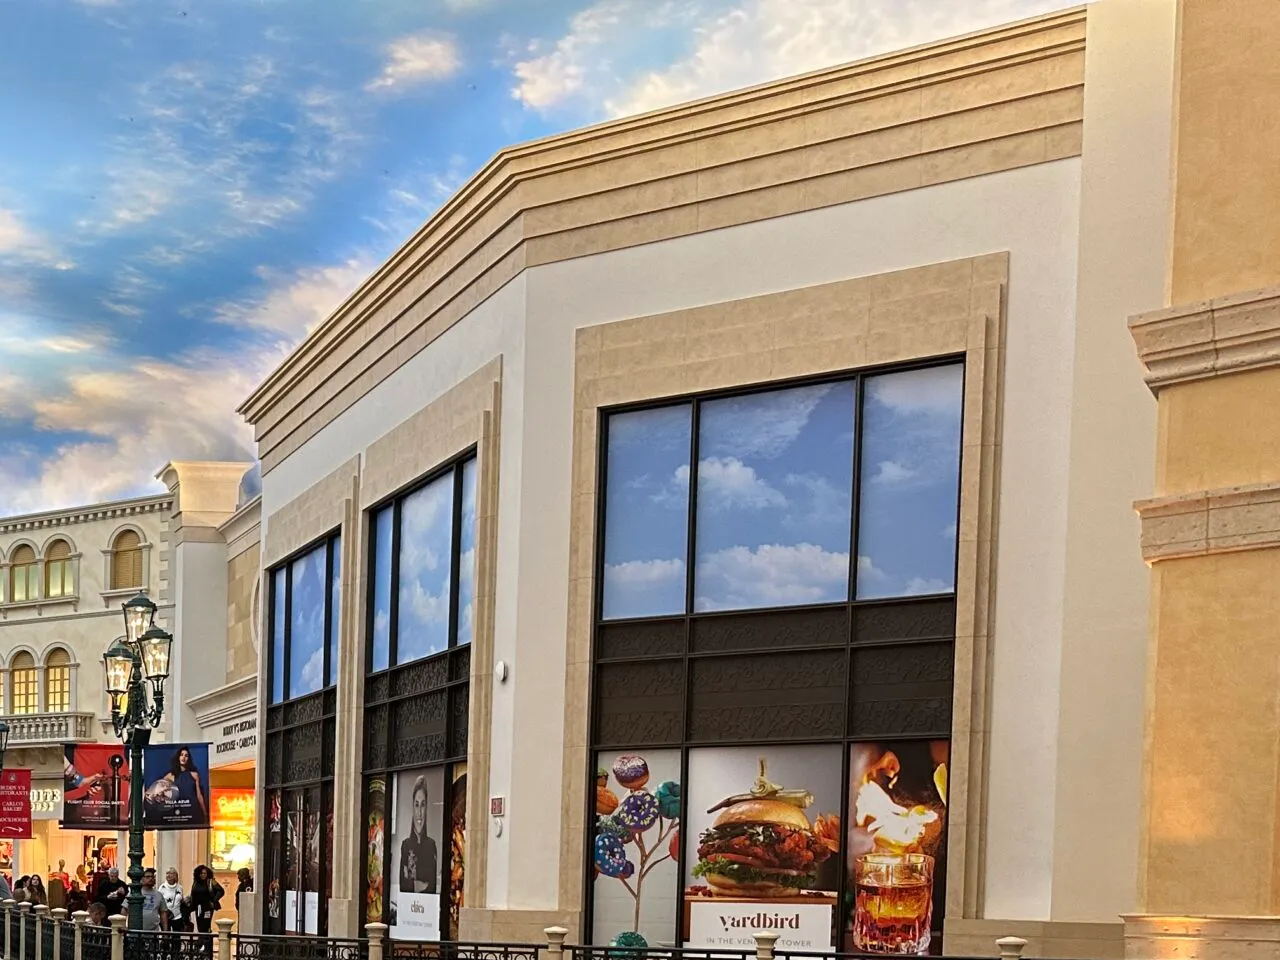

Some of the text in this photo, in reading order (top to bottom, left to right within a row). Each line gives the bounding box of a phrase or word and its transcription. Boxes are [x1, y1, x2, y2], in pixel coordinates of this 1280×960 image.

[720, 913, 800, 932] yardbird
[718, 937, 734, 945] THE
[781, 939, 812, 947] TOWER
